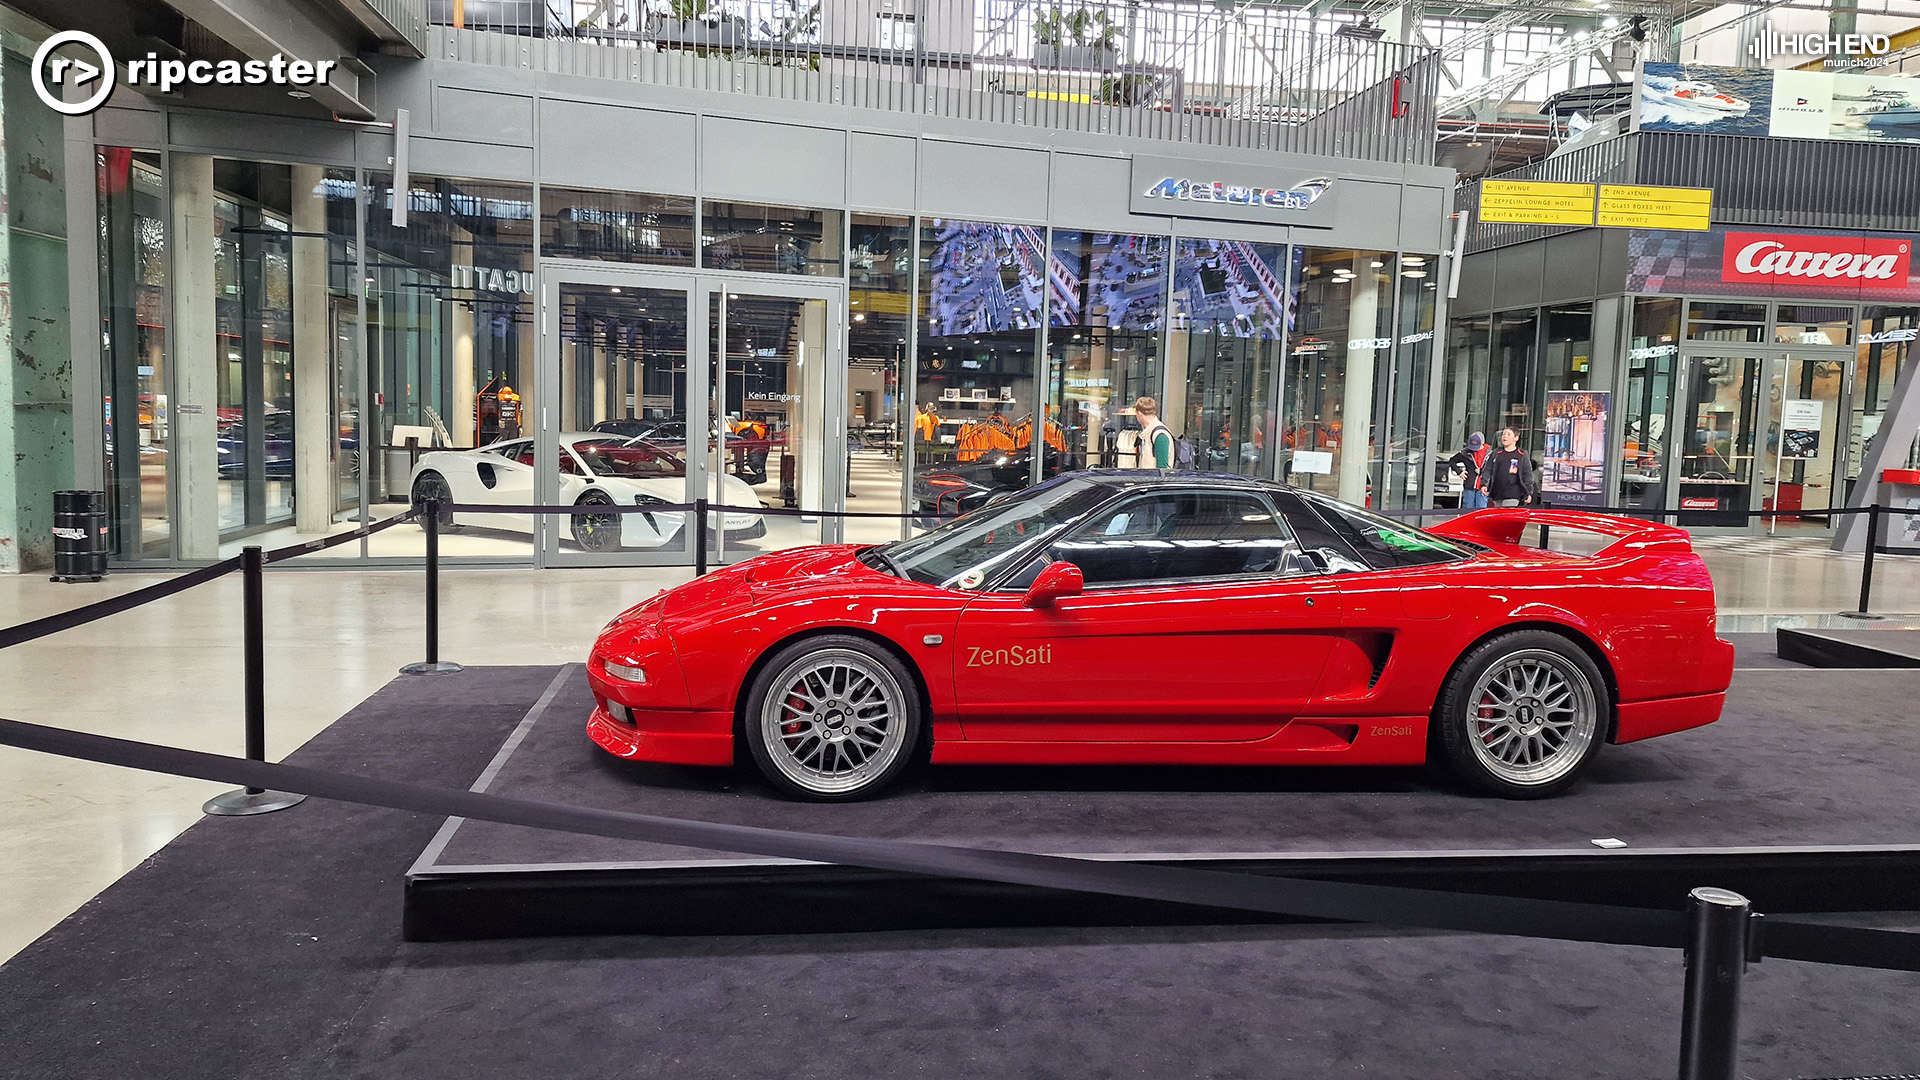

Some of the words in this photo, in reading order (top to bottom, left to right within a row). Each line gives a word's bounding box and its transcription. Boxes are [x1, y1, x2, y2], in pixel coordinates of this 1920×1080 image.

[1144, 177, 1311, 211] McLaren
[1735, 240, 1899, 280] Carrera
[748, 391, 767, 400] Kein
[768, 391, 802, 404] Eingang
[1557, 494, 1587, 502] HIGHLINE
[966, 643, 1051, 667] ZenSati
[1370, 724, 1412, 737] ZenSati
